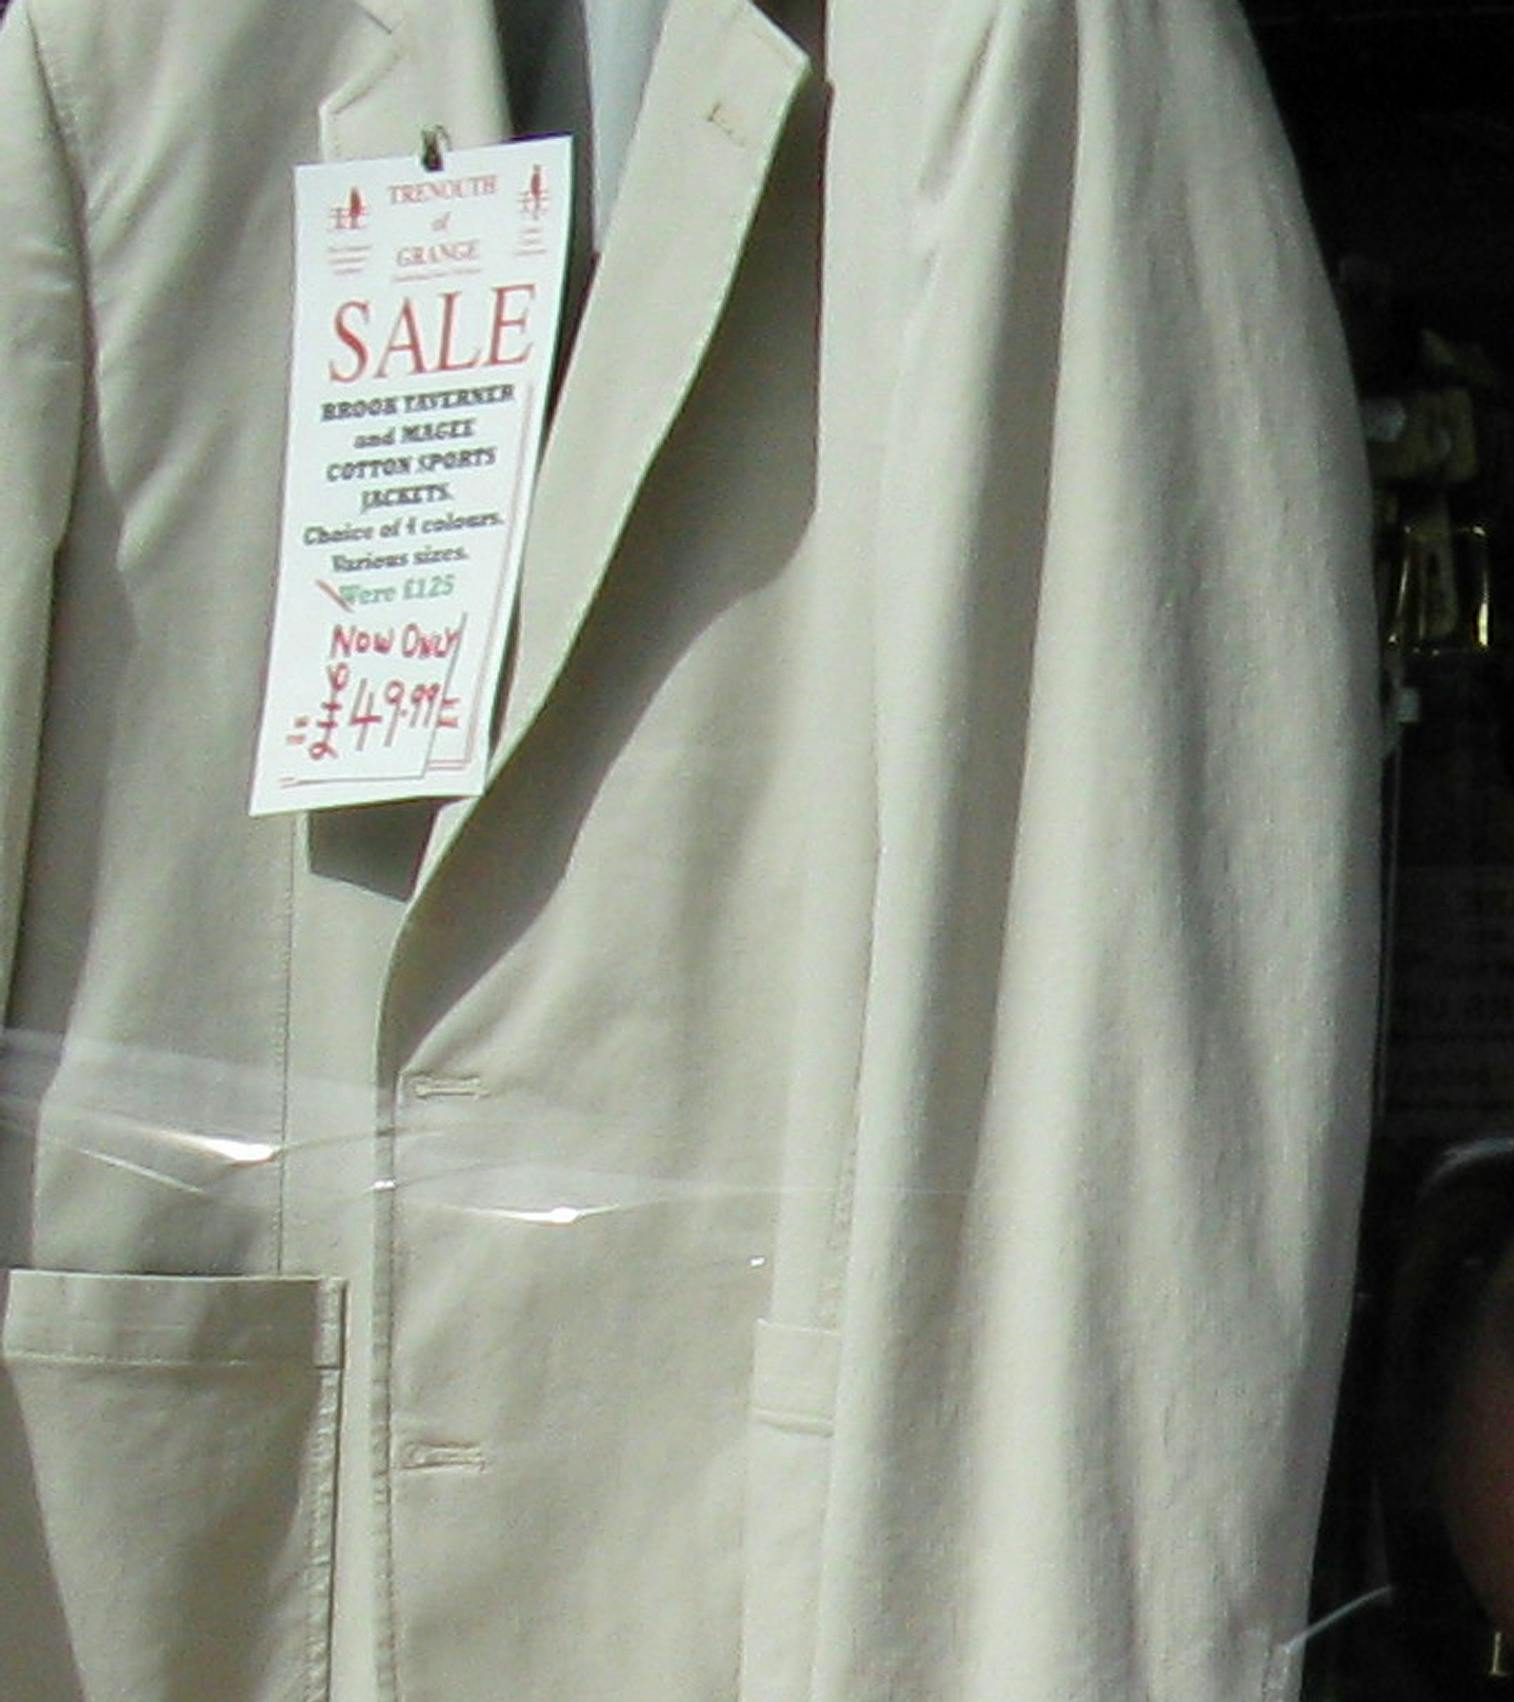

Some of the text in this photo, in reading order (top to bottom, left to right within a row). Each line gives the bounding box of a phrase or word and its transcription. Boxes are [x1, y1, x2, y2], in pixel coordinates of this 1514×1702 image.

[388, 174, 498, 205] TRENOUTH
[430, 211, 451, 232] of
[396, 238, 481, 268] GRANGE
[328, 283, 536, 385] SALE
[319, 383, 515, 422] BROOK TAVERNER
[353, 428, 396, 449] and
[325, 446, 499, 483] COTTON SPORTS
[302, 522, 374, 546] Choice
[379, 516, 403, 539] of
[421, 509, 505, 536] colours.
[331, 550, 409, 574] Various
[338, 574, 457, 606] Were £125
